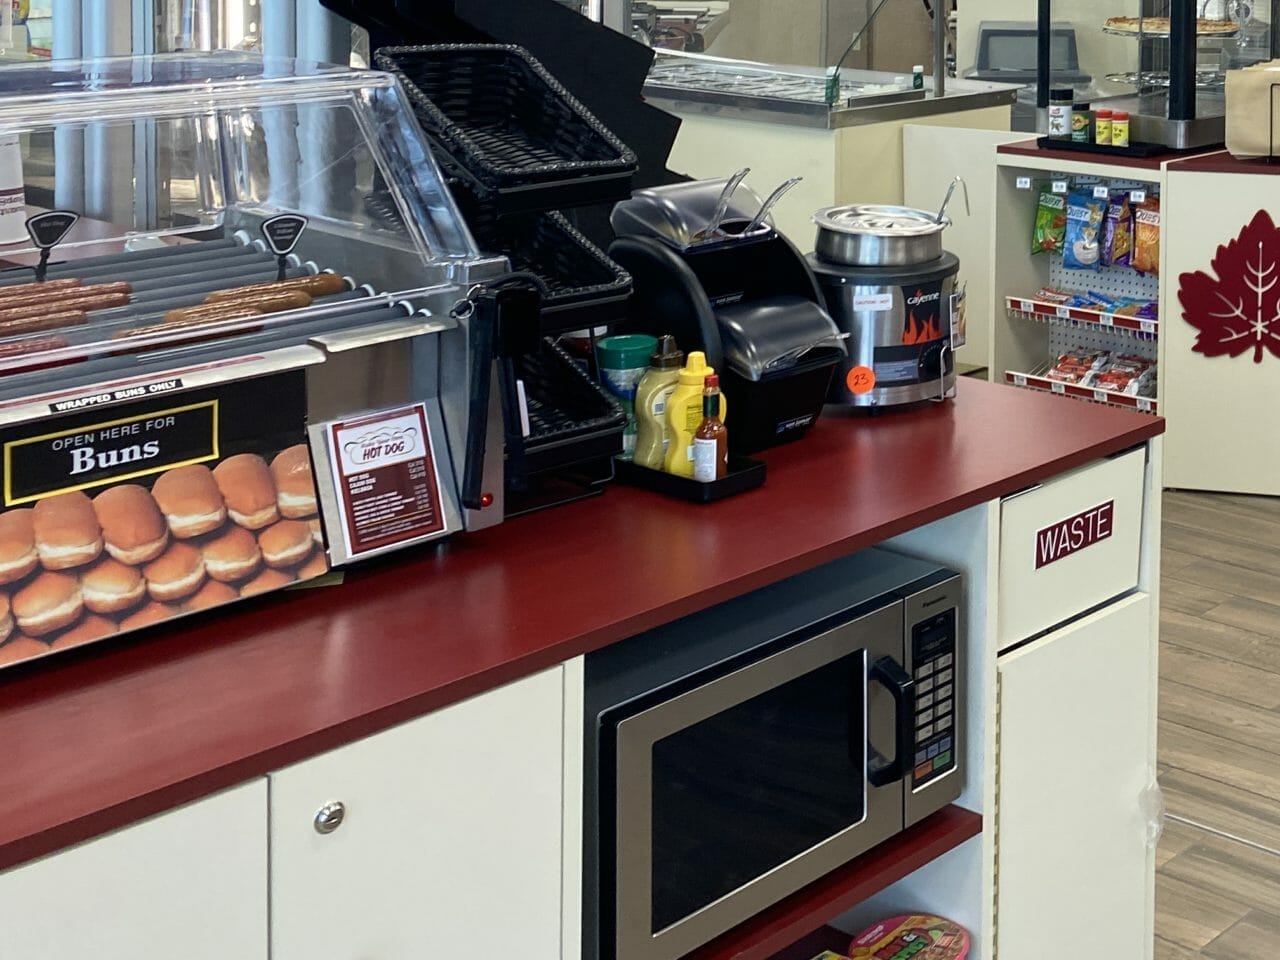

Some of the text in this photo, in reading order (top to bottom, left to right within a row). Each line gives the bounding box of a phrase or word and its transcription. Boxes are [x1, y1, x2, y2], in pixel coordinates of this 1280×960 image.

[1067, 206, 1088, 217] QUEST
[56, 380, 176, 411] WRAPPED BUNS ONLY
[854, 374, 869, 387] 23
[52, 417, 175, 451] OPEN HERE FOR
[69, 440, 160, 475] Buns
[363, 445, 382, 460] HOT
[384, 441, 404, 456] DOG
[1040, 505, 1111, 562] WASTE
